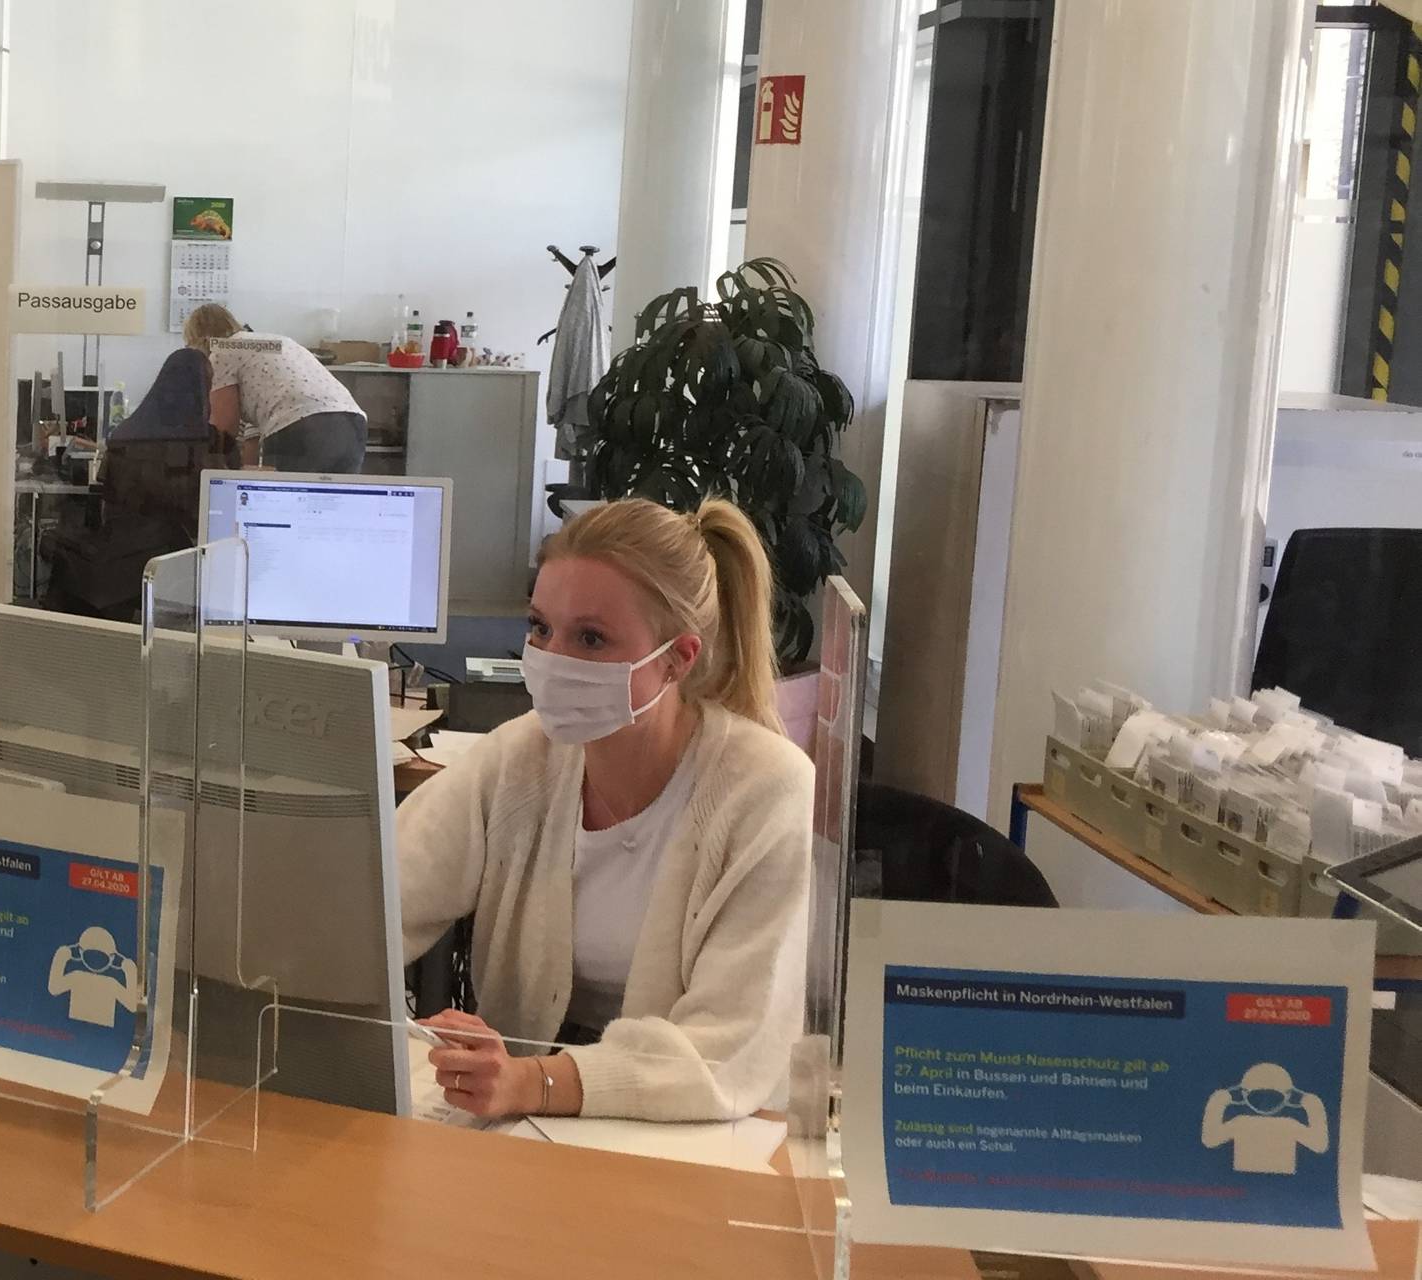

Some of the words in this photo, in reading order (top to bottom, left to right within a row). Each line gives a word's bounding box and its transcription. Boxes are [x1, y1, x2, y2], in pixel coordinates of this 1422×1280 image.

[18, 293, 137, 312] Passausgabe
[210, 339, 282, 352] Passausgabe
[90, 868, 110, 880] GILT
[112, 872, 124, 882] AB
[81, 877, 130, 893] 27.04.2020
[896, 983, 999, 1002] Maskenpflicht
[1002, 990, 1016, 1002] in
[1020, 990, 1173, 1011] Nordrhein-Westfalen
[894, 1046, 941, 1061] Pflicht
[944, 1051, 976, 1063] zum
[980, 1051, 1119, 1071] Mund-Nasenschutz
[1123, 1059, 1146, 1074] gilt
[1151, 1060, 1169, 1072] ab
[894, 1064, 913, 1077] 27.
[919, 1065, 953, 1081] April
[957, 1067, 971, 1080] in
[974, 1068, 1027, 1083] Bussen
[1030, 1072, 1058, 1085] und
[1062, 1072, 1117, 1088] Bahnen
[1121, 1077, 1148, 1090] und
[894, 1082, 929, 1095] beim
[933, 1083, 1006, 1100] Einkaufen.
[895, 1119, 945, 1136] Zulässig
[976, 1125, 1048, 1141] sogenannte
[1050, 1128, 1142, 1144] Alltagsmasken
[895, 1136, 922, 1148] oder
[925, 1138, 955, 1150] auch
[958, 1140, 976, 1151] ein
[980, 1140, 1016, 1153] Schal.
